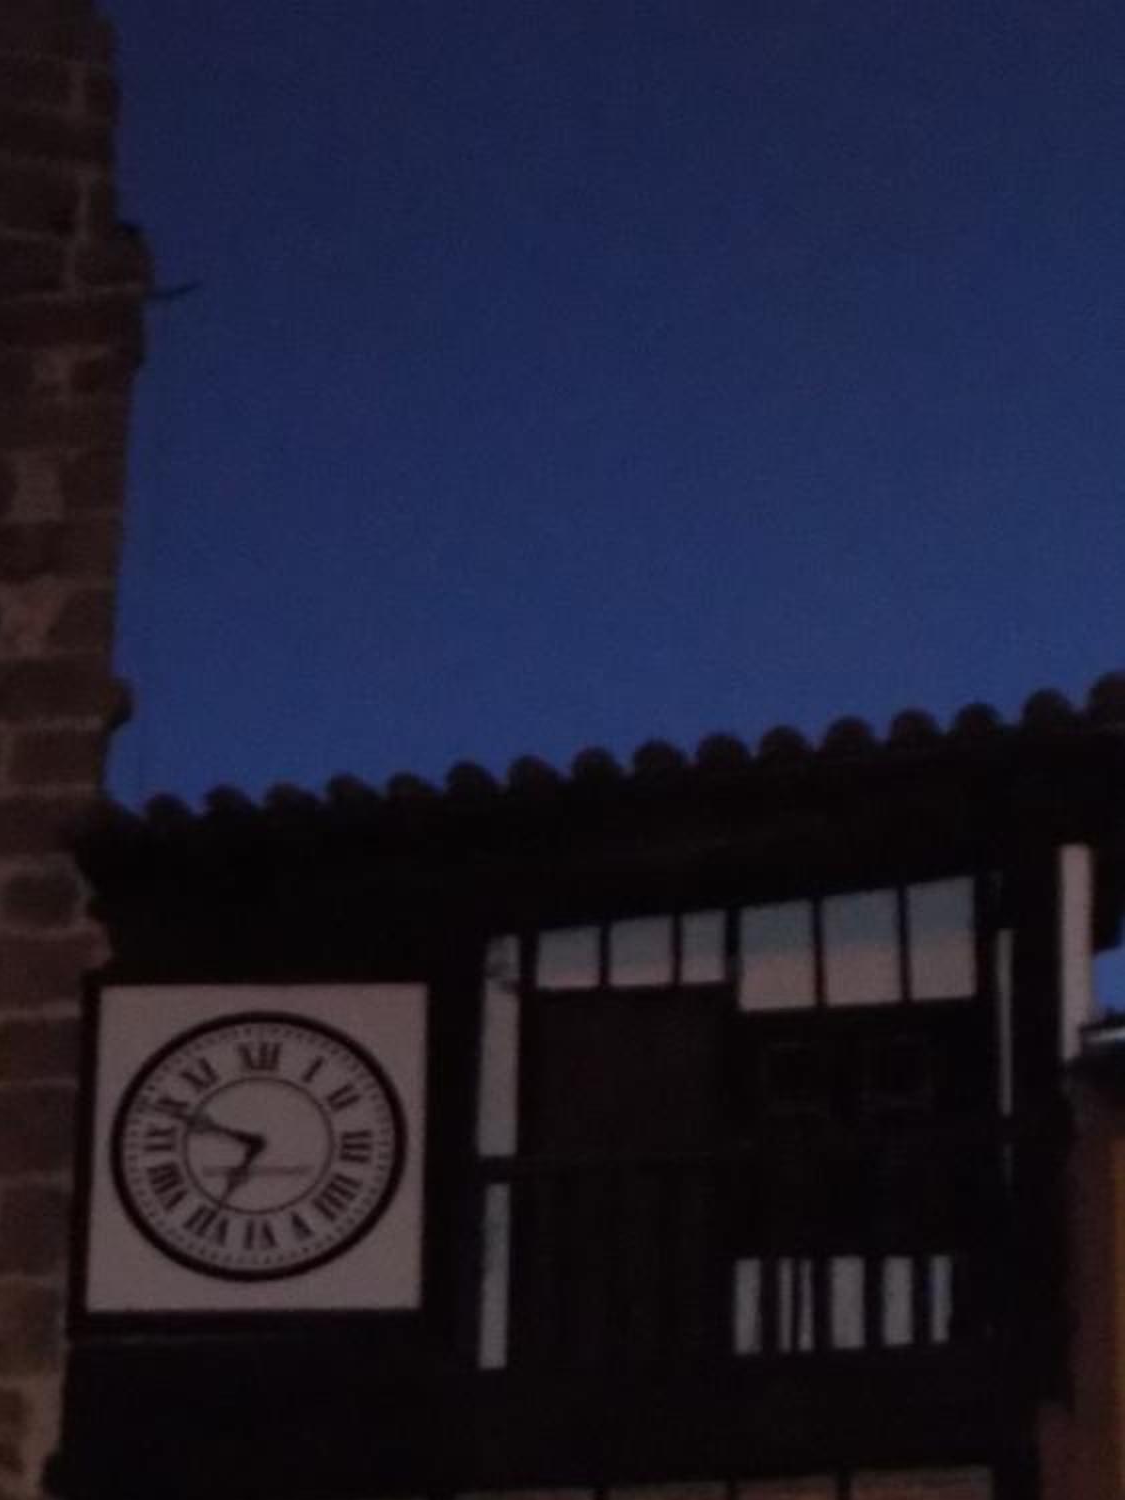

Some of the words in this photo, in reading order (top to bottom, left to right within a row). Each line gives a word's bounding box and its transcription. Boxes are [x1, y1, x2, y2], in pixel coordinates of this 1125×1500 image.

[178, 1056, 222, 1094] XI
[233, 1042, 284, 1073] XII
[300, 1055, 327, 1084] I
[324, 1082, 363, 1113] II
[141, 1124, 181, 1153] IX
[338, 1128, 374, 1164] III
[144, 1159, 190, 1215] VIII
[310, 1172, 364, 1223] IIII
[181, 1204, 232, 1249] VII
[242, 1216, 281, 1251] VI
[289, 1210, 316, 1243] V
